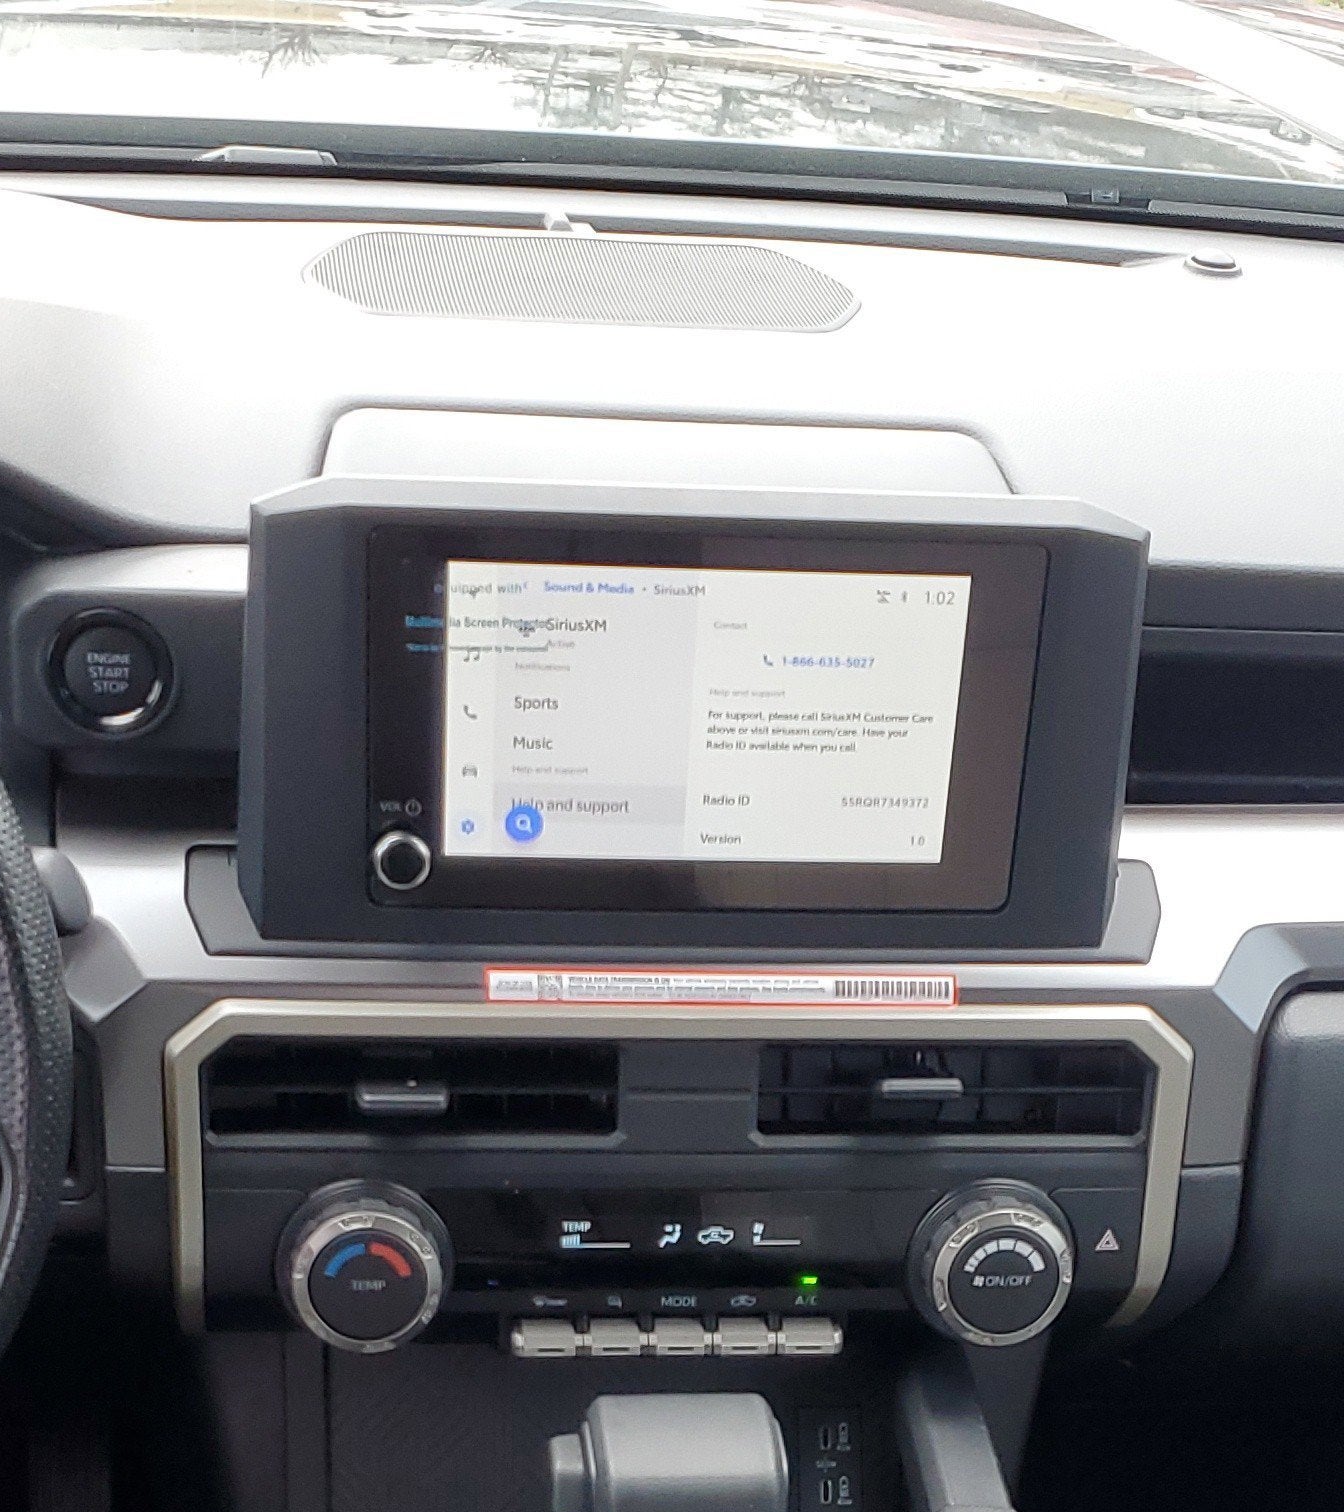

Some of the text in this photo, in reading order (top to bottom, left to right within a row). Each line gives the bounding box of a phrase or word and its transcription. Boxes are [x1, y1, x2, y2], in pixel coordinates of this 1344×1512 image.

[544, 582, 706, 597] Sound & Media SiriusXM
[924, 590, 955, 606] 1:02
[463, 616, 500, 629] Screen
[546, 618, 607, 633] SiriusXM
[88, 666, 130, 679] START
[93, 681, 130, 693] STOP
[513, 696, 559, 712] Sports
[708, 710, 723, 720] For
[768, 712, 799, 723] please
[512, 736, 554, 751] Music
[547, 798, 573, 813] and
[577, 799, 630, 815] support
[703, 795, 751, 806] Radio ID
[700, 833, 742, 845] Version
[561, 1220, 592, 1233] TEMP
[351, 1279, 387, 1292] TEMP
[984, 1274, 1031, 1288] ON/OFF
[661, 1295, 698, 1307] MODE
[794, 1294, 818, 1307] A/C
